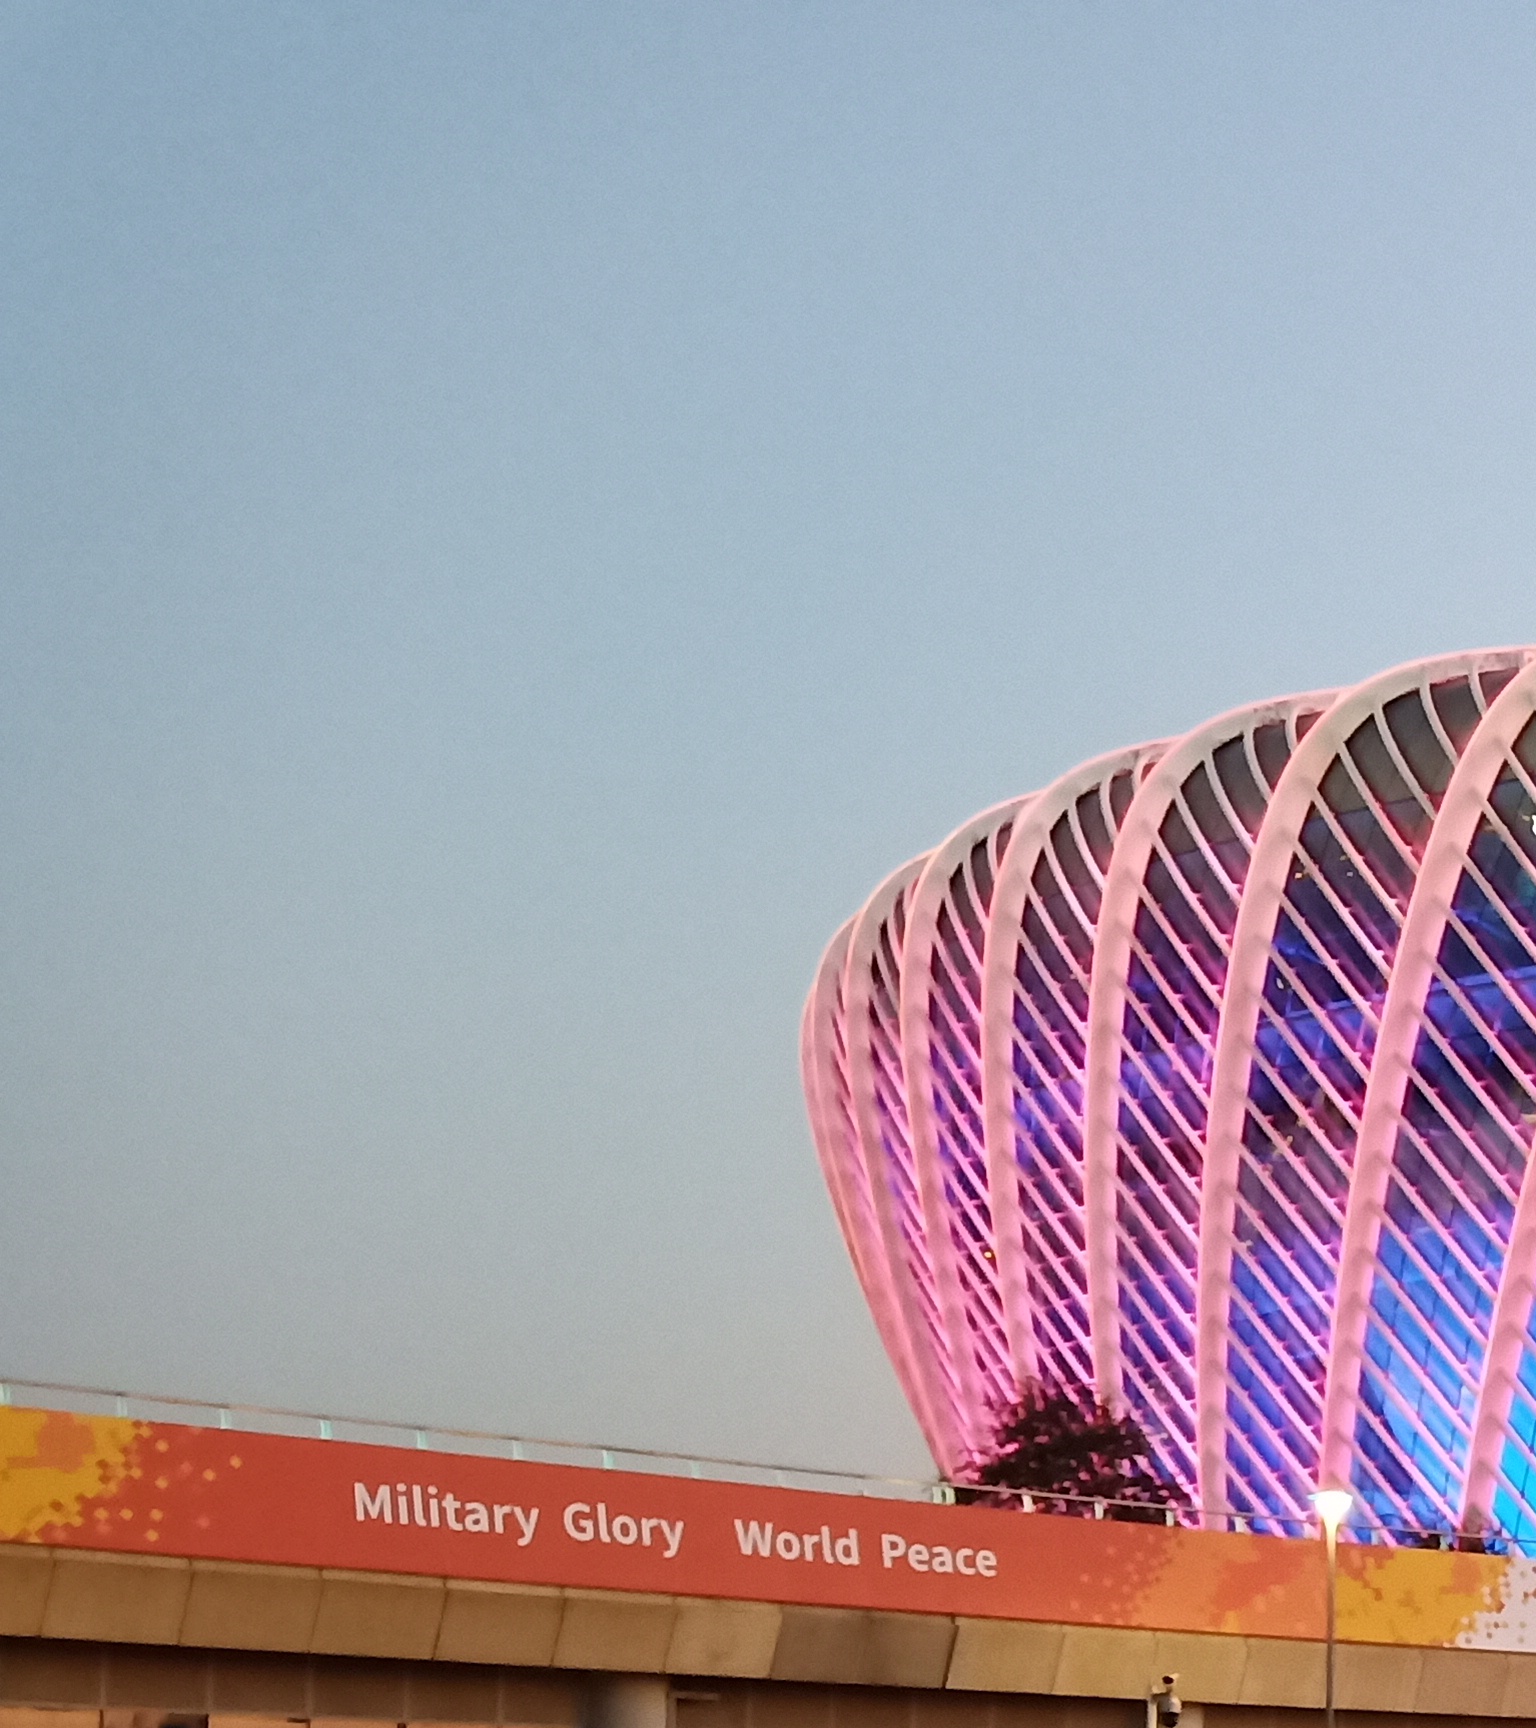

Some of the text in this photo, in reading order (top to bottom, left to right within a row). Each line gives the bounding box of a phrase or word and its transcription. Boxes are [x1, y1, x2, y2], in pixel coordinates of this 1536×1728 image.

[353, 1482, 998, 1577] Military Glory World Peace
